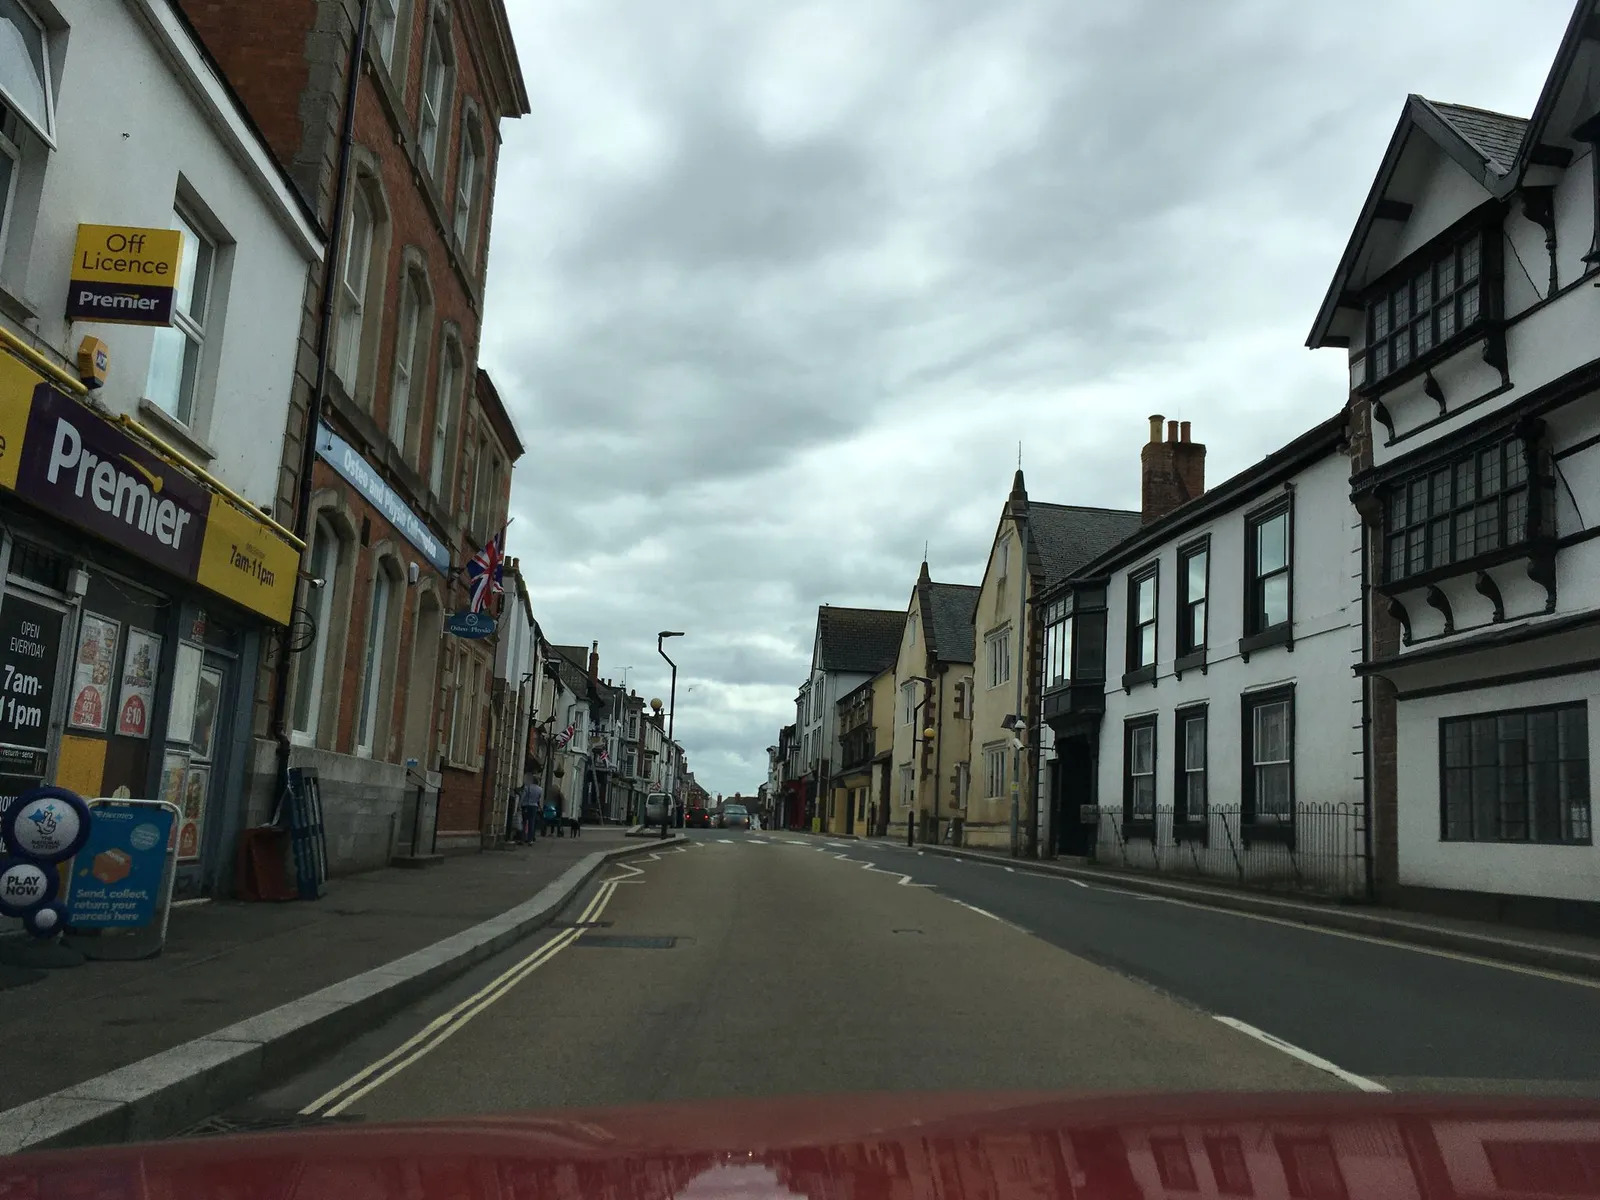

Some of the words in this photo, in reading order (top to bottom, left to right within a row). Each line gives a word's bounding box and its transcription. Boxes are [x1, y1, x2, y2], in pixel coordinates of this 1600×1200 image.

[107, 233, 146, 253] Off
[82, 251, 169, 274] Licence
[78, 291, 160, 310] Premier
[47, 417, 191, 550] Premier
[344, 449, 369, 488] Osteo
[369, 479, 385, 504] and
[230, 544, 275, 587] 7am-11pm
[21, 621, 40, 639] OPEN
[10, 637, 46, 658] EVERYDAY
[4, 664, 42, 696] 7am-
[125, 706, 142, 725] £10
[103, 811, 134, 820] Hermes
[6, 886, 39, 895] NOW
[7, 876, 40, 886] PLAY
[76, 888, 107, 899] Send,
[109, 888, 149, 900] collect,
[74, 901, 110, 910] return
[111, 902, 137, 911] your
[71, 911, 111, 922] parcels
[113, 911, 140, 921] here
